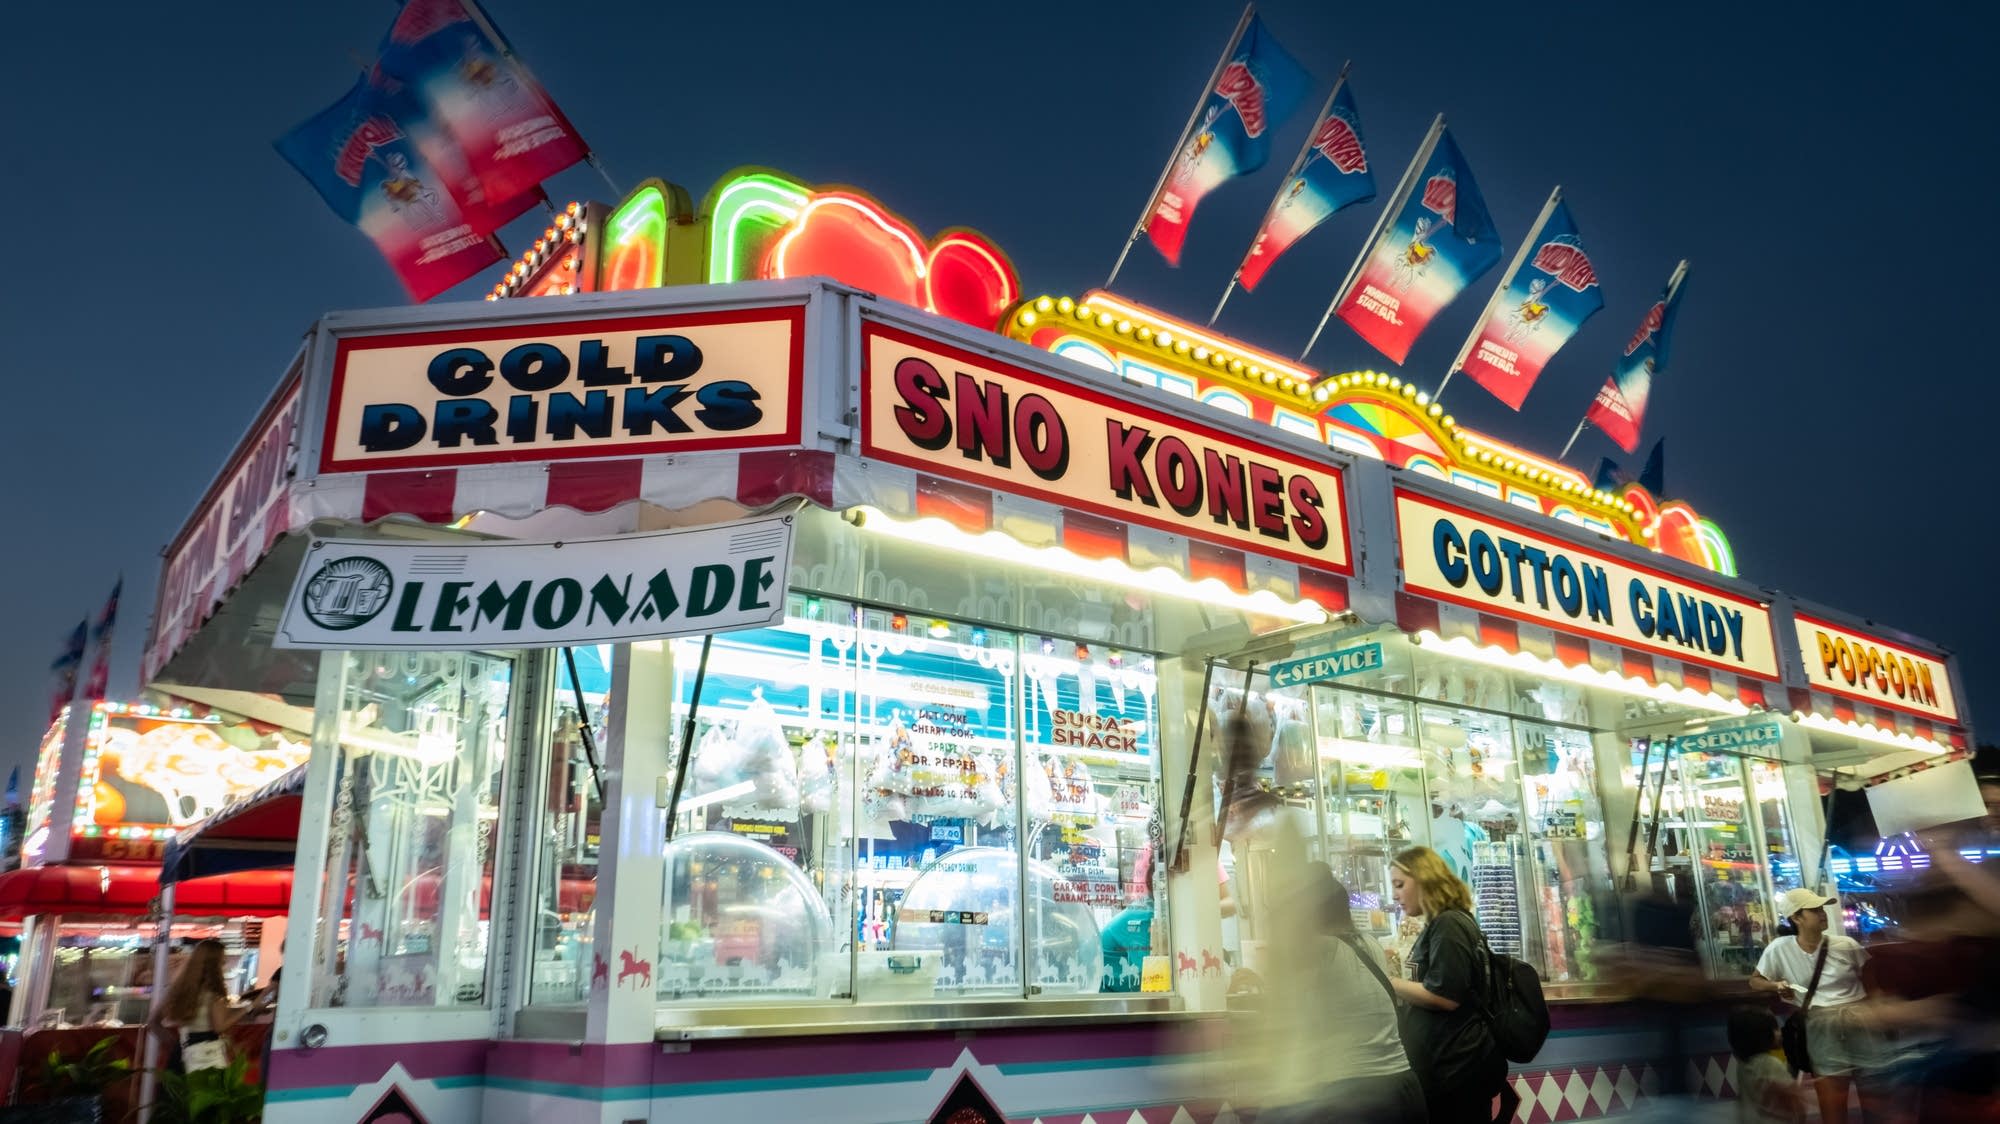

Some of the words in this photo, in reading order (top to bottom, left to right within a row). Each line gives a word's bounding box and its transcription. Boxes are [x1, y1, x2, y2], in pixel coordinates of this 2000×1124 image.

[427, 334, 704, 397] COLD
[358, 380, 764, 453] DRINKS
[894, 356, 1069, 482] SNO
[1106, 417, 1328, 550] KONES
[391, 555, 775, 633] LEMONADE
[1433, 518, 1614, 627] COTTON
[1629, 577, 1744, 662] CANDY
[1291, 649, 1378, 682] SERVICE
[1815, 630, 1940, 709] POPCORN
[911, 723, 947, 736] CHERRY
[942, 713, 967, 724] COKE
[1053, 710, 1136, 735] SUGAR
[928, 741, 958, 753] SPRITE
[1053, 728, 1137, 753] SHACK
[1696, 726, 1778, 749] SERVICE
[912, 755, 931, 767] DR.
[935, 757, 976, 771] PEPPER
[1704, 795, 1739, 809] SUGAR
[1705, 806, 1740, 820] SHACK
[1053, 882, 1091, 892] CARAMEL
[1095, 884, 1116, 893] CORN
[1053, 893, 1091, 903] CARAMEL
